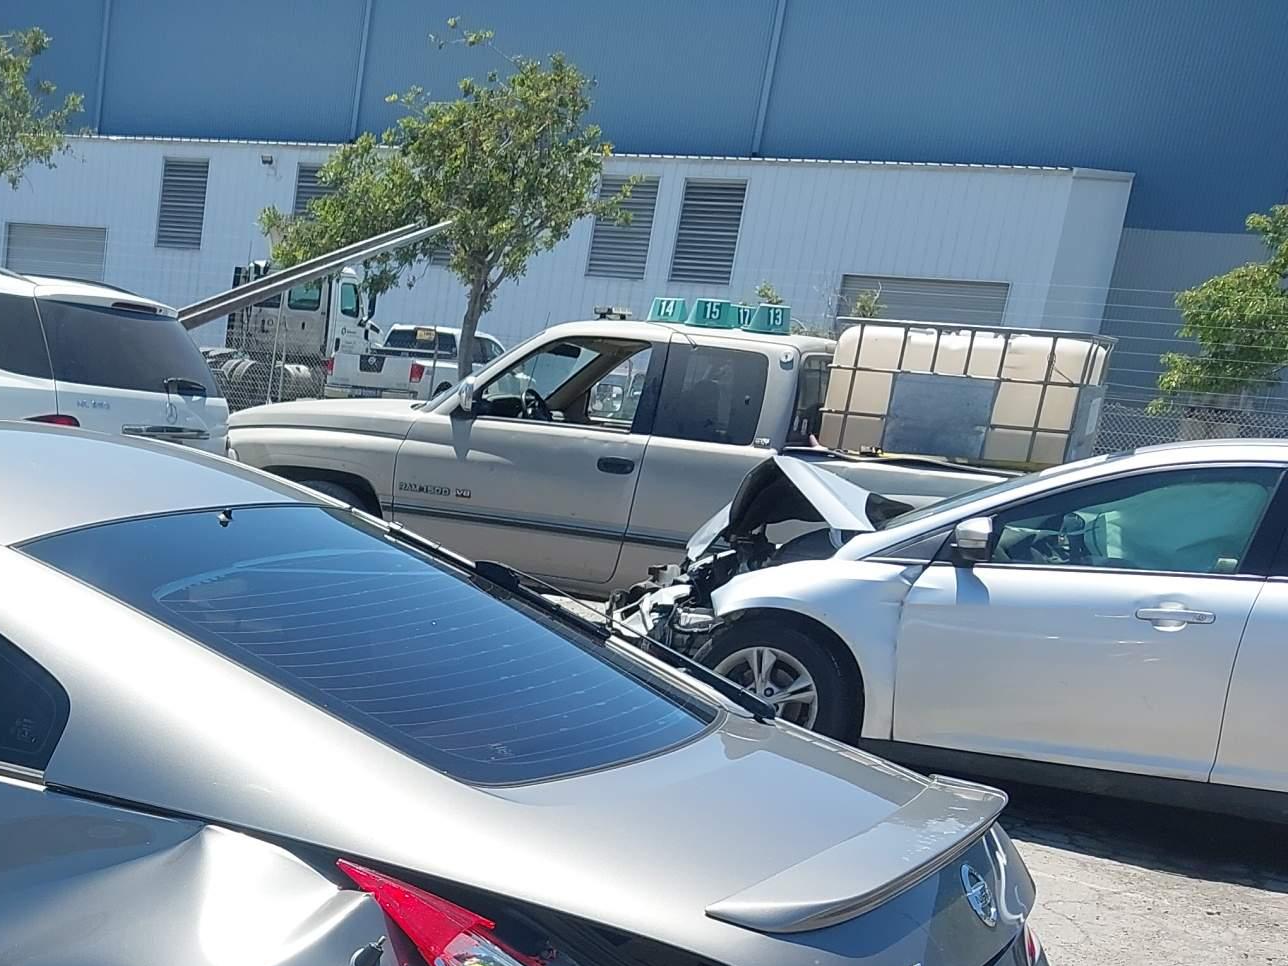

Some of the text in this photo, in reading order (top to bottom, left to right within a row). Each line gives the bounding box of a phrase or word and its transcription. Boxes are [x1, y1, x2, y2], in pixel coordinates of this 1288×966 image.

[660, 299, 676, 317] 14
[704, 301, 721, 320] 15
[738, 307, 751, 326] 17
[768, 308, 783, 326] 13
